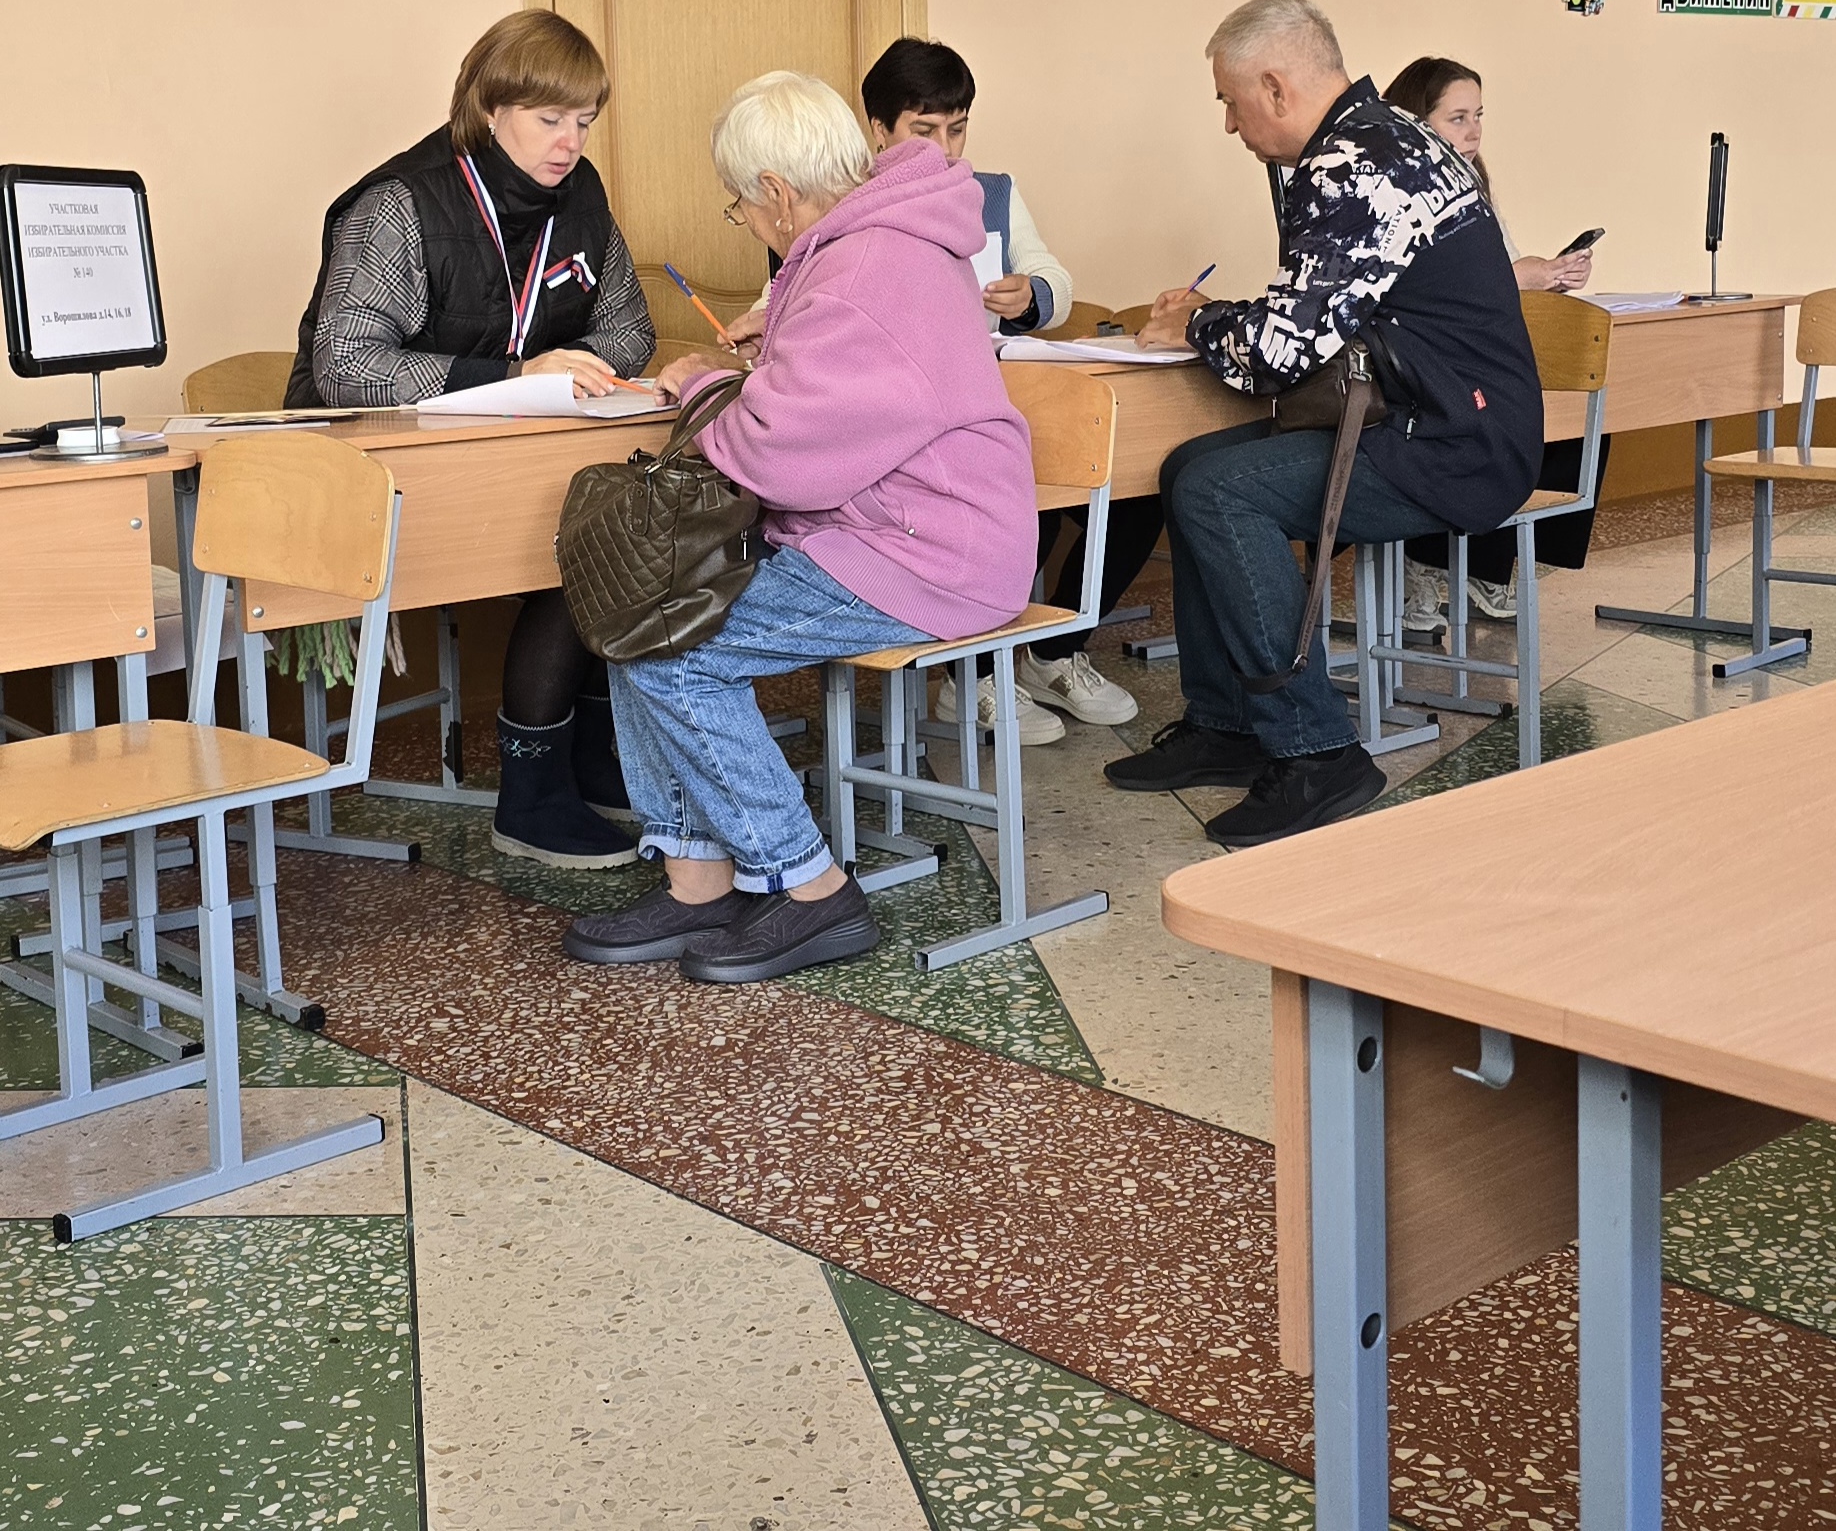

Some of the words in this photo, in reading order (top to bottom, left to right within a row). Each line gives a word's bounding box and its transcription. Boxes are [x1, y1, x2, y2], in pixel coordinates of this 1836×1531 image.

[48, 203, 99, 215] УЧАСТКОВАЯ
[24, 224, 86, 236] ИЗБИРАТЕЛЬНАЯ
[86, 224, 127, 236] КОМИССИЯ
[27, 246, 94, 259] ИЗБИРАТЕЛЬНОГО
[94, 245, 129, 257] УЧАСТКА
